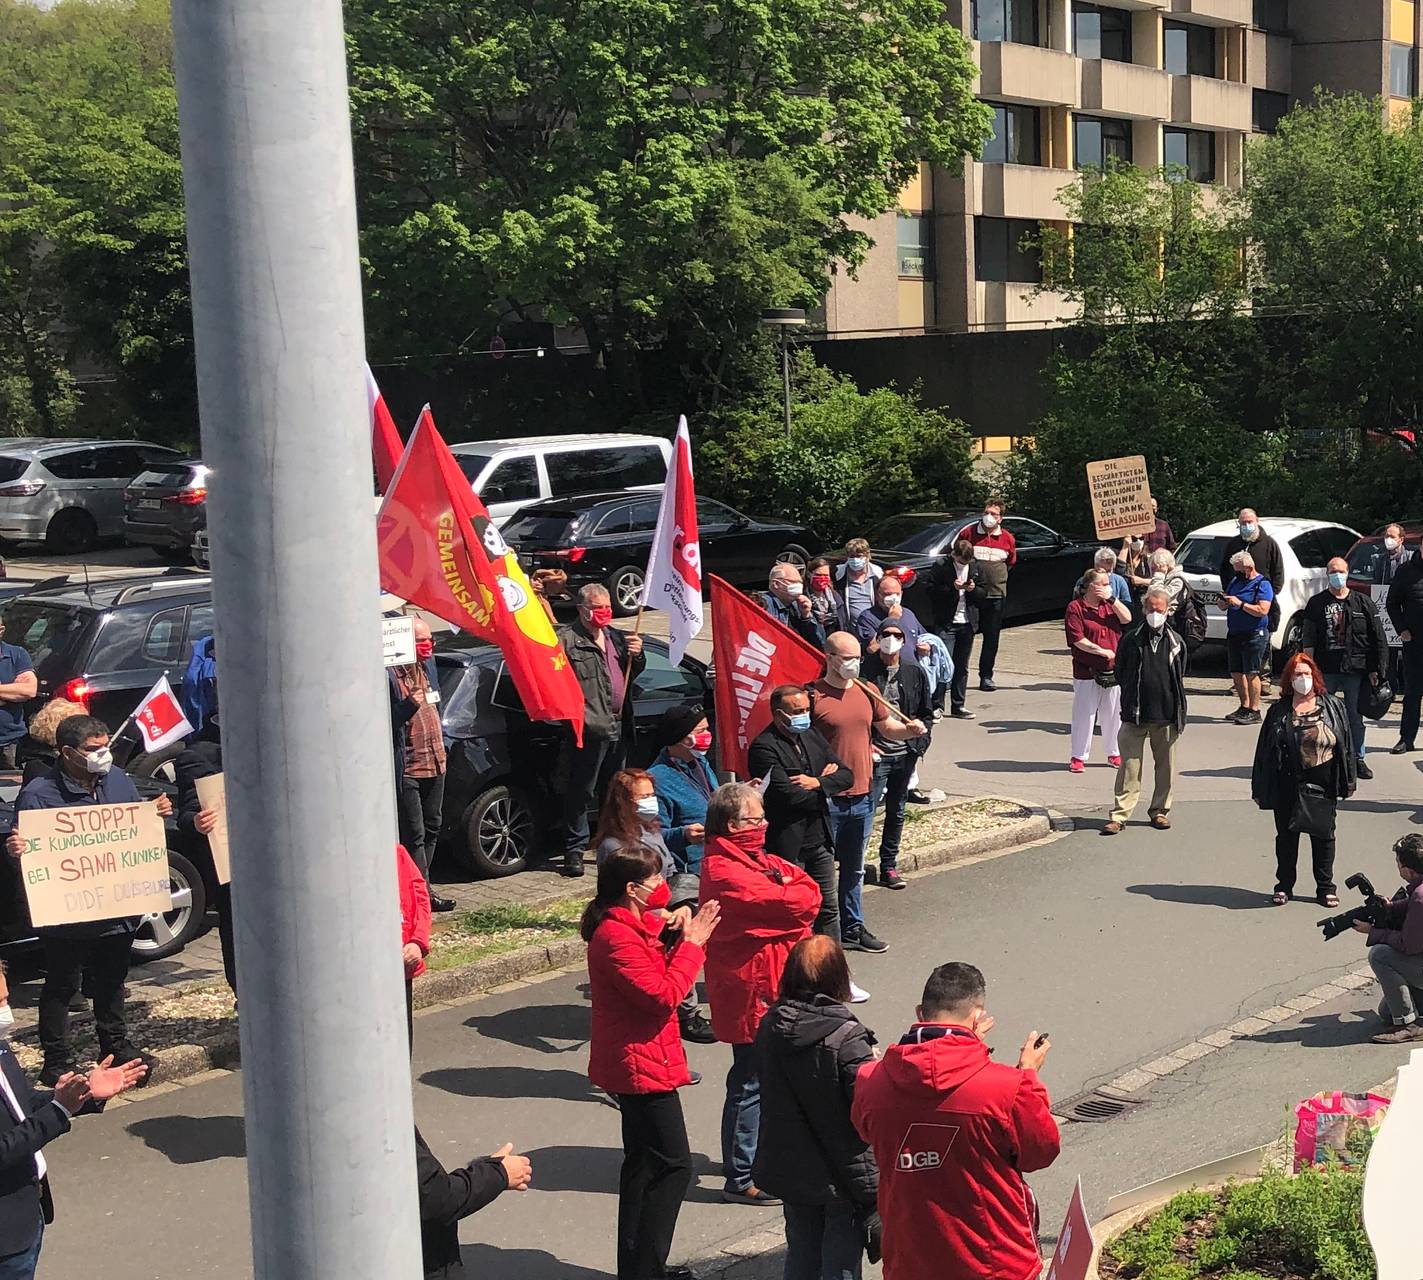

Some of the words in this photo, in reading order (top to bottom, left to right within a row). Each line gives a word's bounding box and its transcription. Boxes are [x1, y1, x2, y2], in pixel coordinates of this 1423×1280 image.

[1104, 463, 1118, 471] DIE
[1103, 484, 1142, 498] MILLIONEN
[1098, 512, 1150, 529] ENTLASSUNG
[1100, 509, 1116, 517] DER
[438, 512, 490, 627] GEMEINSAM
[735, 630, 777, 677] DIE
[55, 806, 140, 833] STOPPT
[23, 838, 41, 854] DIE
[28, 867, 50, 885] BEI
[60, 852, 117, 882] SANA
[900, 1151, 941, 1169] DGB
